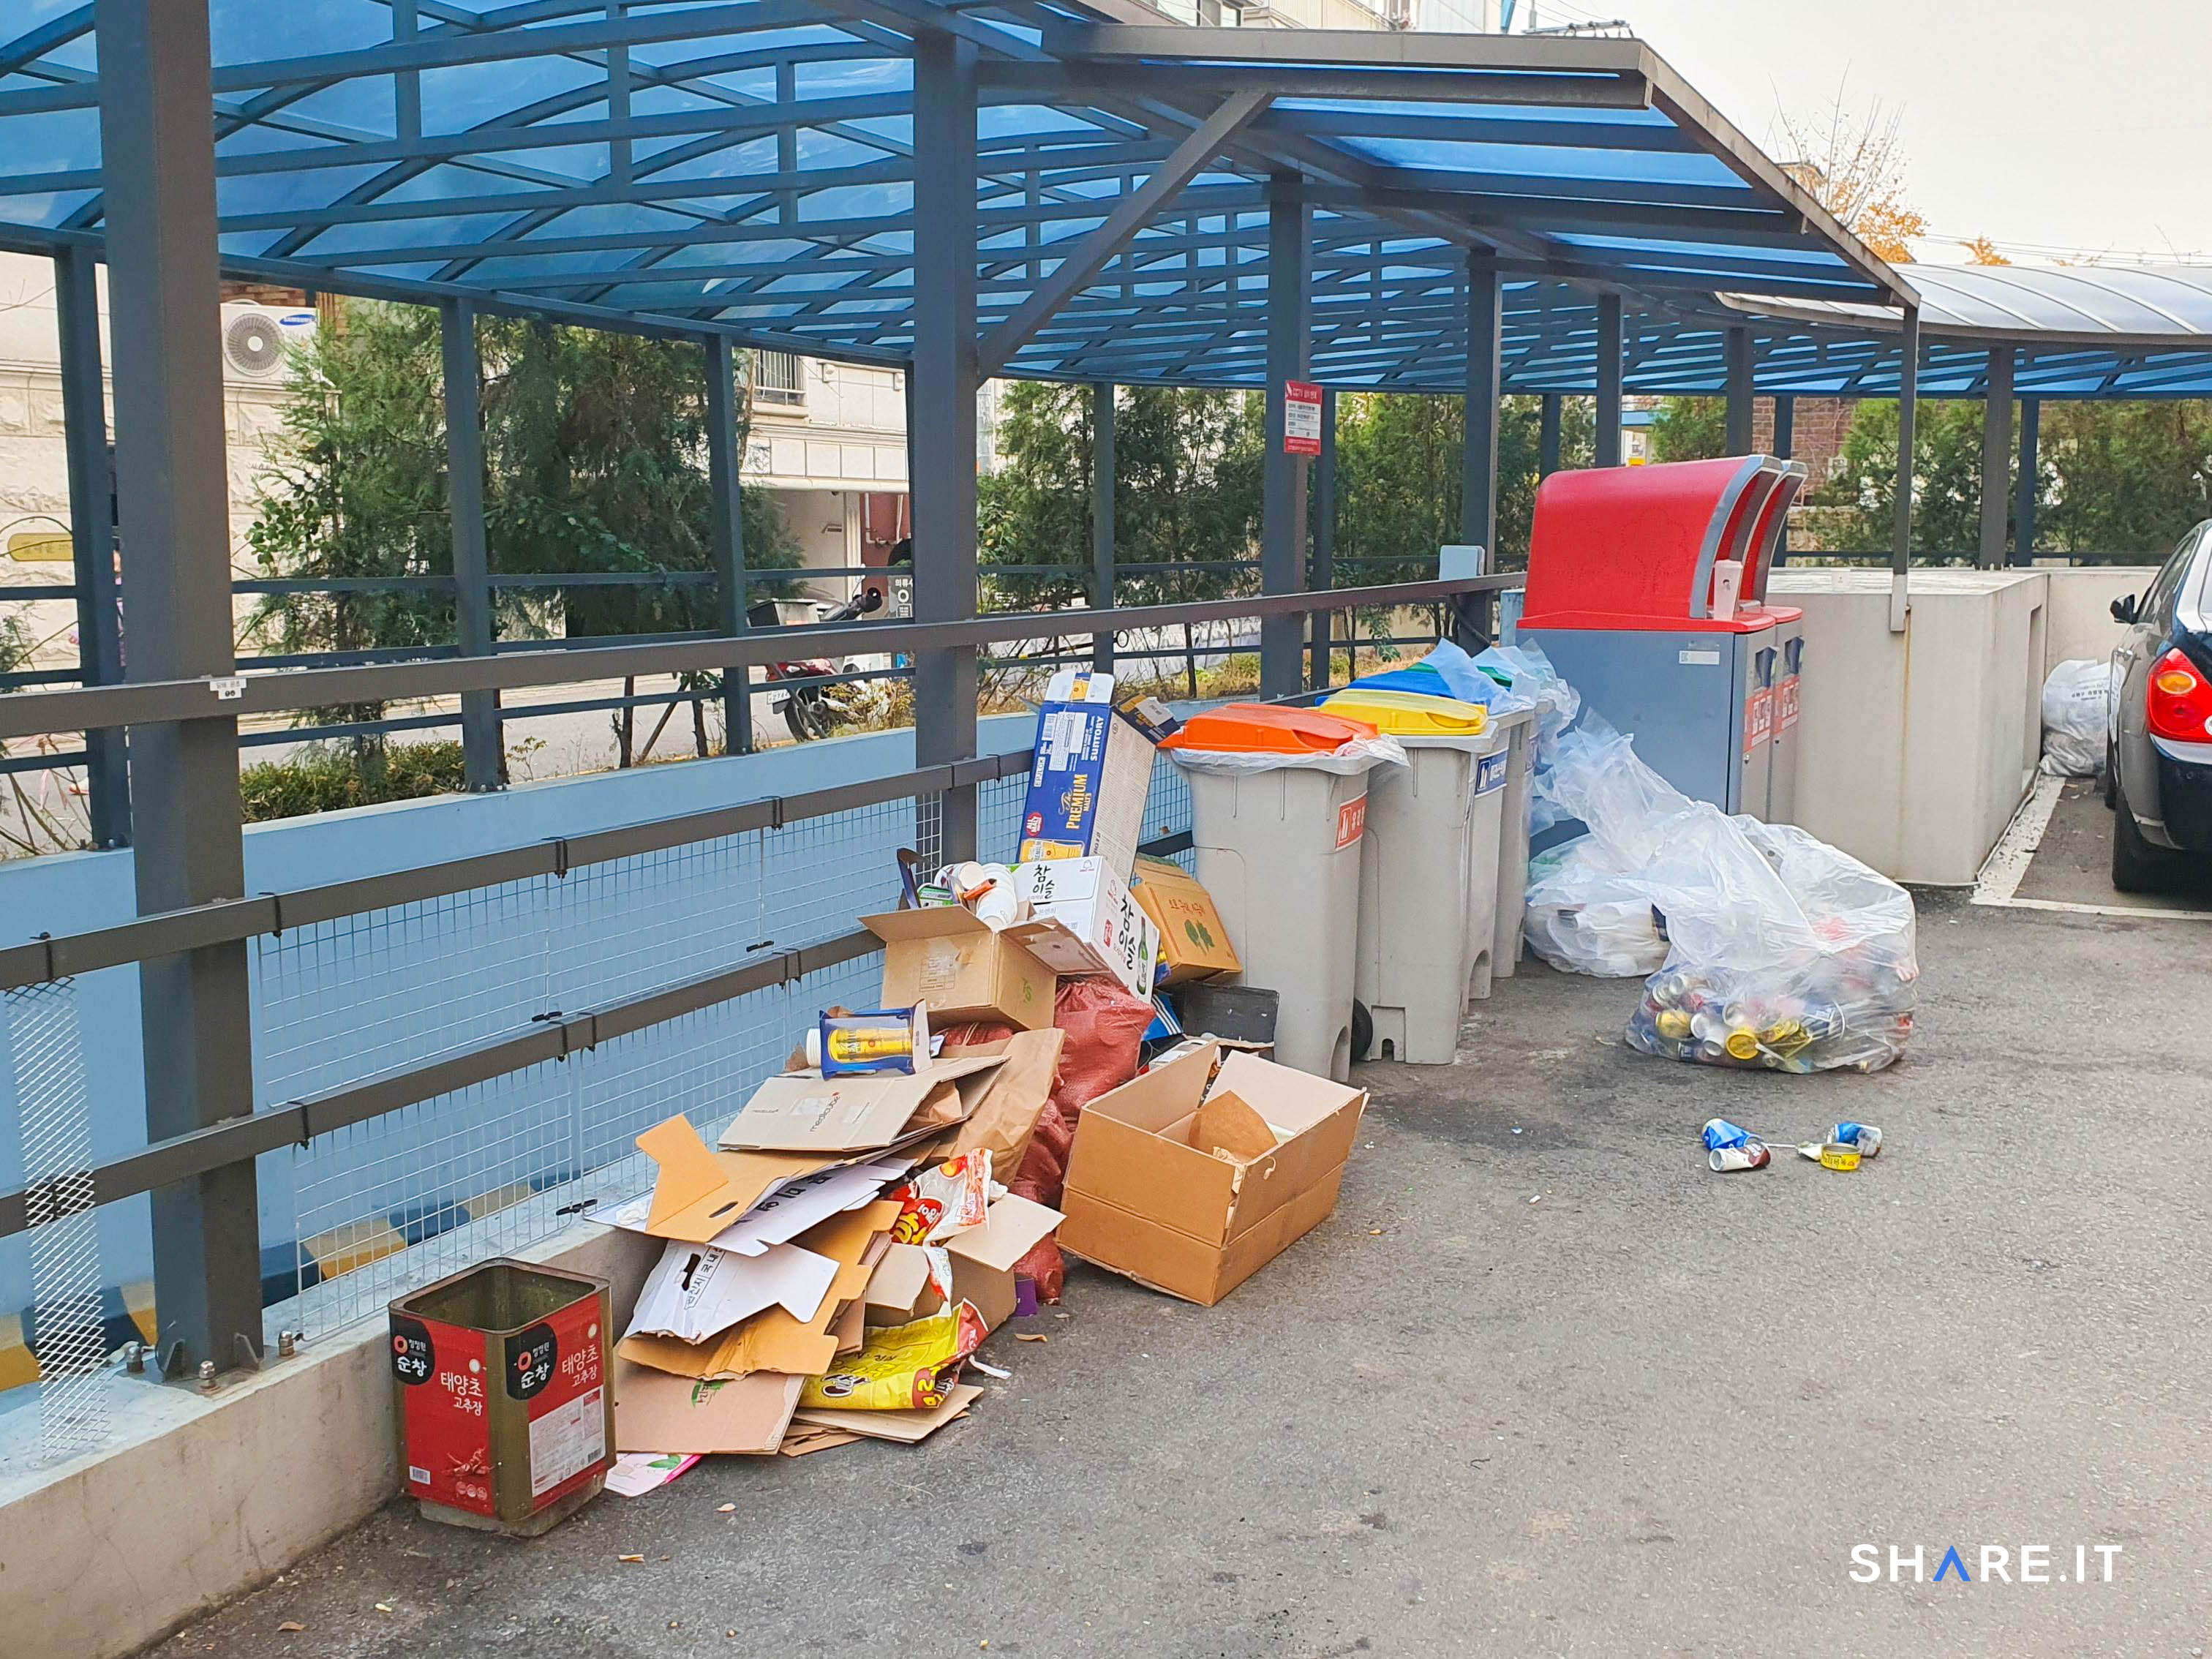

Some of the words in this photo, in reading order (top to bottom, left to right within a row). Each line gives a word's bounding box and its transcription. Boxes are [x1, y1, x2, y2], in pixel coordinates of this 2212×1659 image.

[1065, 773, 1088, 830] PREMIUM
[397, 1355, 427, 1377] 순창
[561, 1344, 599, 1374] 태양초
[440, 1372, 484, 1398] 태양초
[520, 1362, 550, 1389] 순창
[571, 1364, 598, 1388] 고추장
[453, 1396, 483, 1417] 고추장
